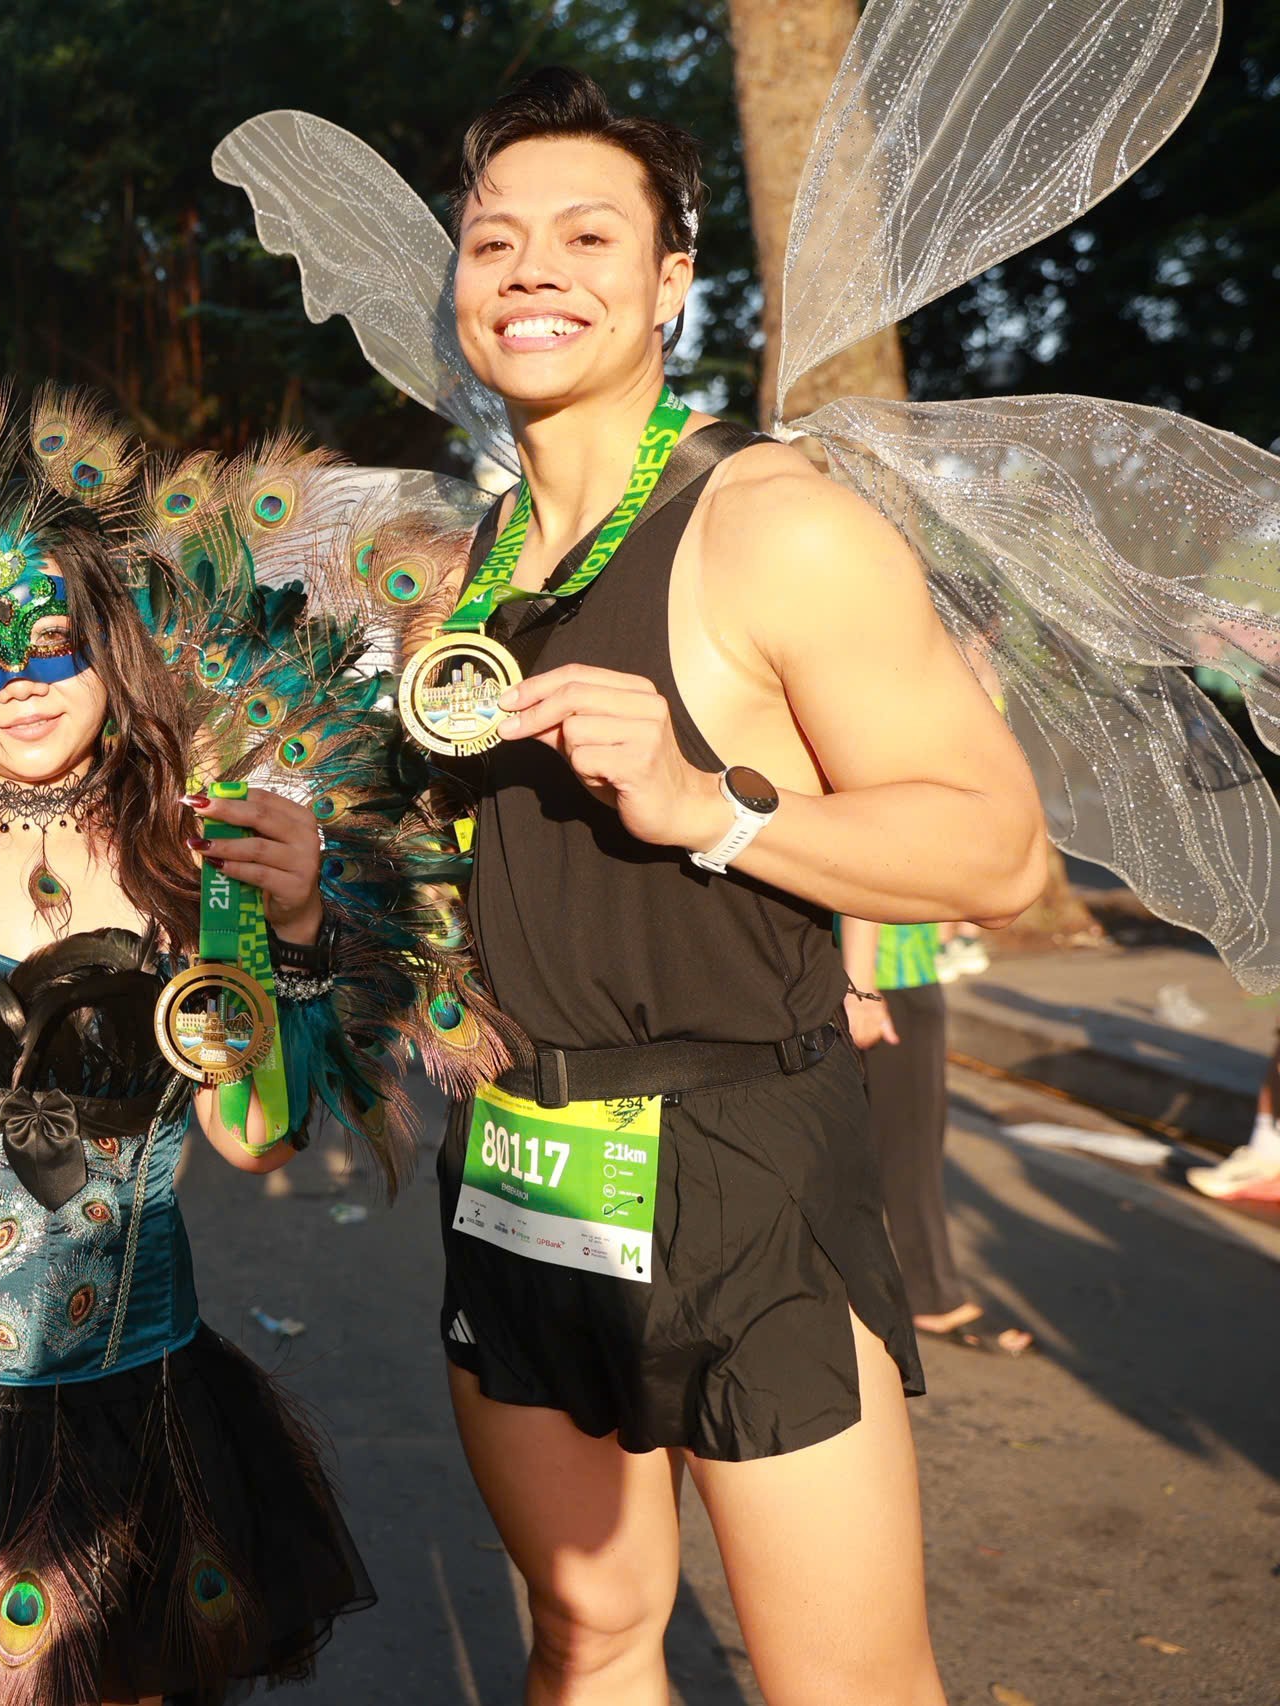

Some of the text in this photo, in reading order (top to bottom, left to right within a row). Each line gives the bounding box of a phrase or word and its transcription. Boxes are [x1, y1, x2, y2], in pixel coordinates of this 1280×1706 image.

[602, 426, 679, 530] VIBES
[457, 732, 502, 757] HANOI
[209, 872, 231, 910] 21k
[207, 1064, 252, 1084] HANOI
[618, 1095, 643, 1109] 254
[481, 1120, 570, 1189] 80117
[604, 1141, 647, 1165] 21km
[621, 1243, 640, 1266] M
